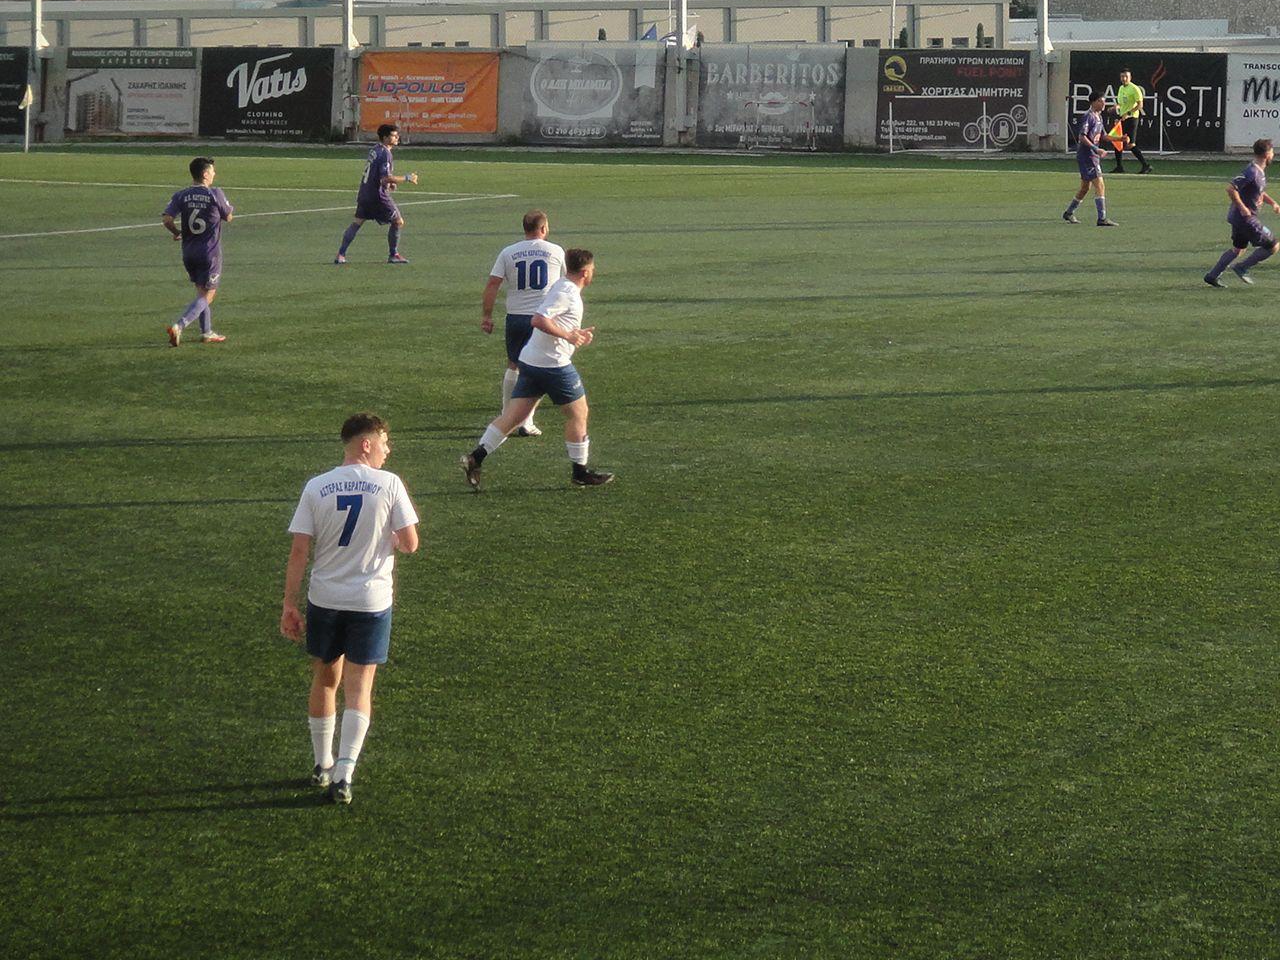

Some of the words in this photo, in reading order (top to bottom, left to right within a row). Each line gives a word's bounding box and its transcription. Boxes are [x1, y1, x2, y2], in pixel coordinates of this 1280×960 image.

[919, 56, 957, 65] ΠΡΑΤΗΡΙΟ
[958, 57, 984, 65] ΥΓΡΩΝ
[985, 57, 1025, 66] ΚΑΥΣΙΜΩΝ
[706, 62, 840, 85] BARBERITOS
[921, 86, 966, 97] ΧΟΡΤΣΑΣ
[968, 87, 1024, 98] ΔΗΜΗΤΡΗΣ
[1242, 109, 1279, 119] ΔΙΚΤΥΟ
[1165, 118, 1221, 128] coffee
[188, 208, 206, 235] 6
[514, 259, 548, 290] 10
[336, 494, 363, 547] 7
